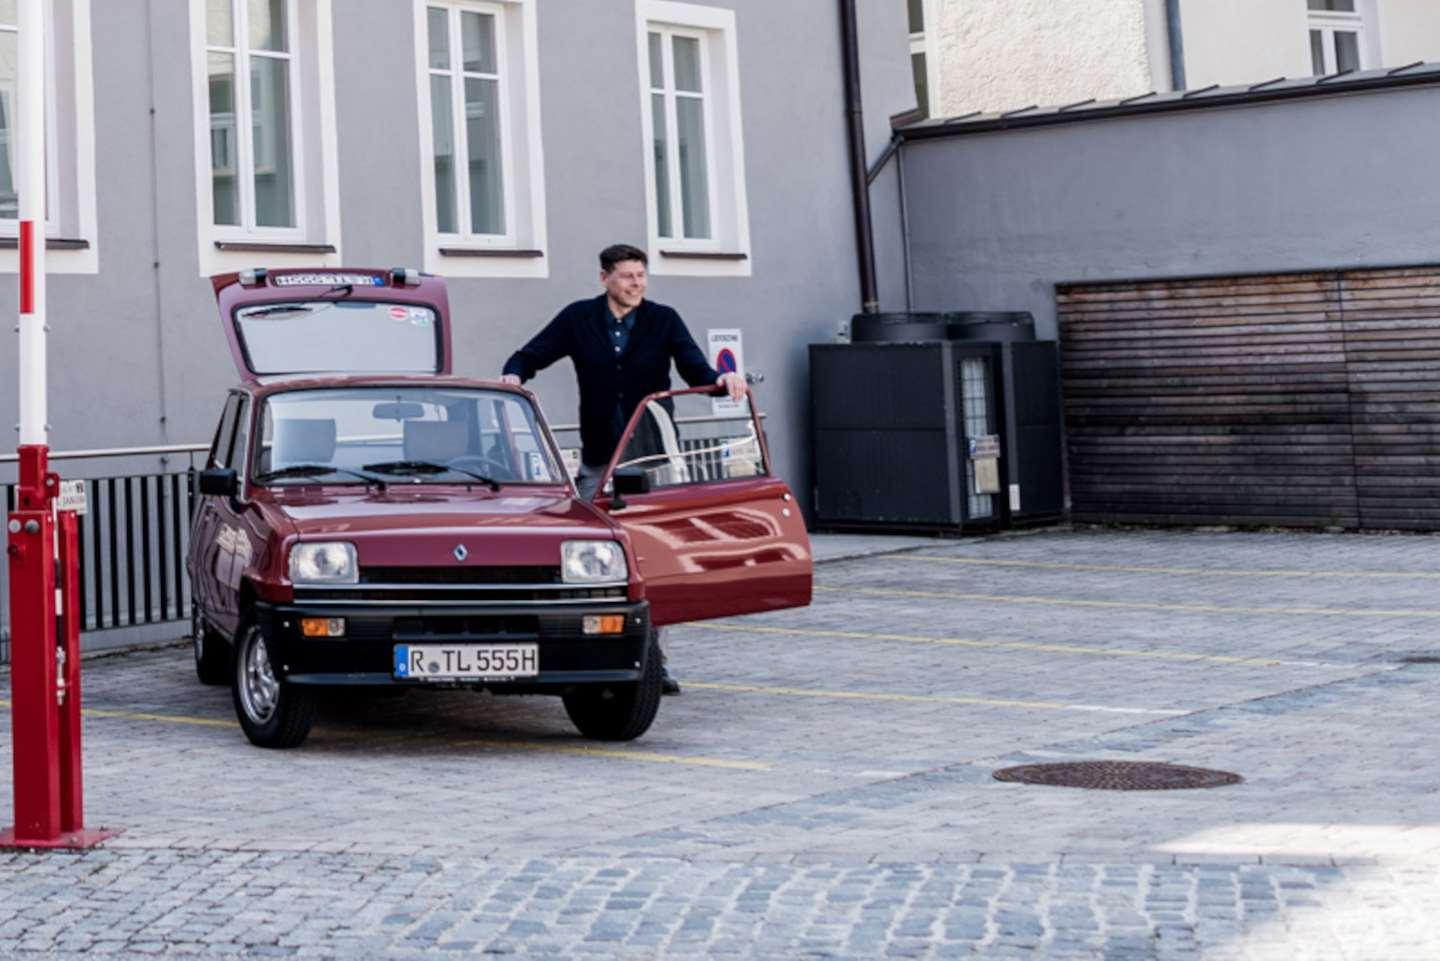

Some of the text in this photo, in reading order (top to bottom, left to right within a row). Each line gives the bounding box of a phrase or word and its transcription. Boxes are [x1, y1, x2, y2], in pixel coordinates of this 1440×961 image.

[410, 649, 536, 672] R TL 555H
